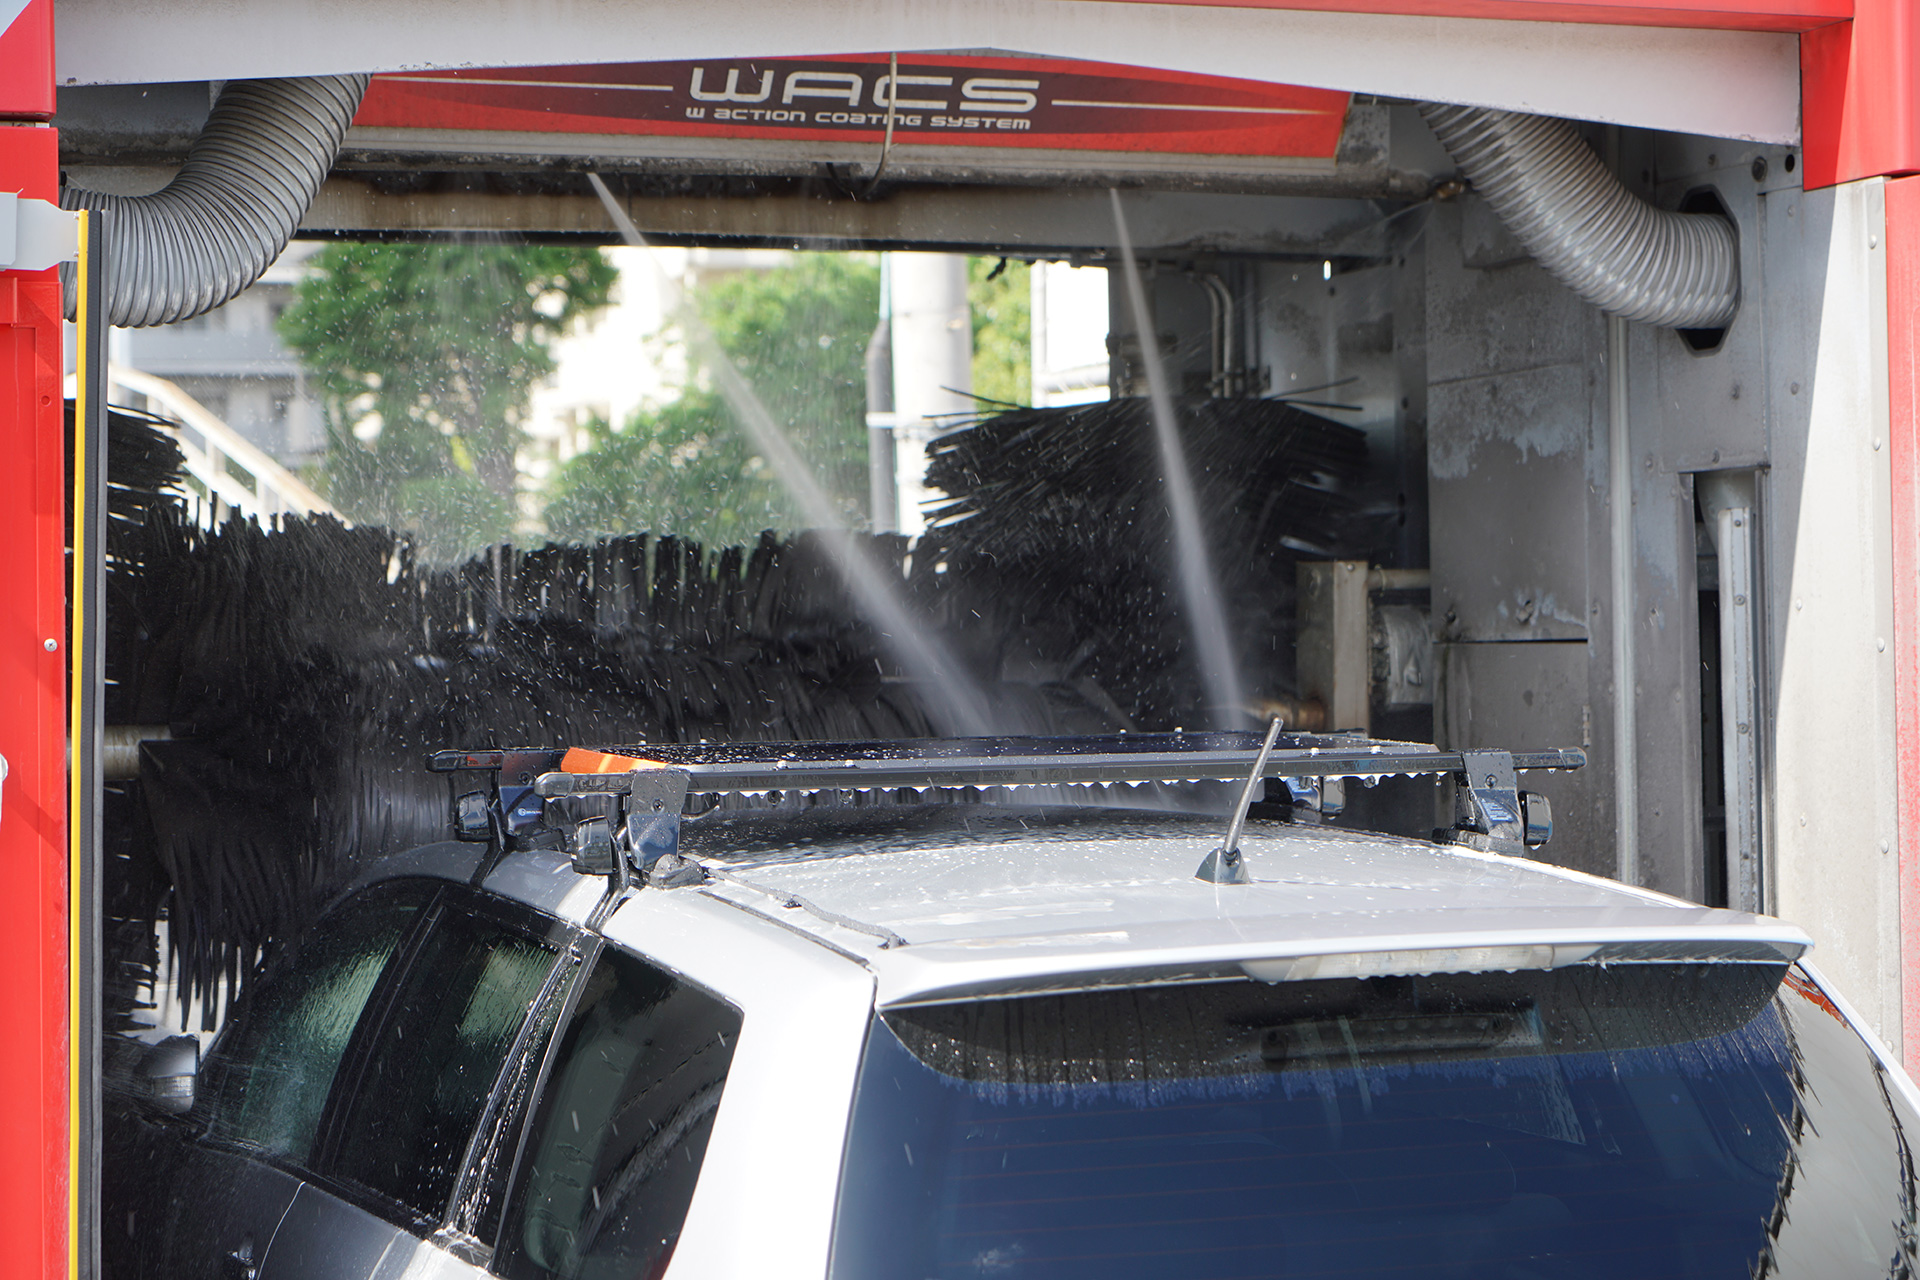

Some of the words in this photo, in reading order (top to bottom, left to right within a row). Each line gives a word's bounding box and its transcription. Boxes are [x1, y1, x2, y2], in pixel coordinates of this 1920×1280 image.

[689, 67, 1040, 113] WACS
[685, 107, 706, 119] W
[713, 108, 806, 122] ACTION
[814, 112, 923, 127] COATING
[929, 116, 1032, 130] SYSTEM
